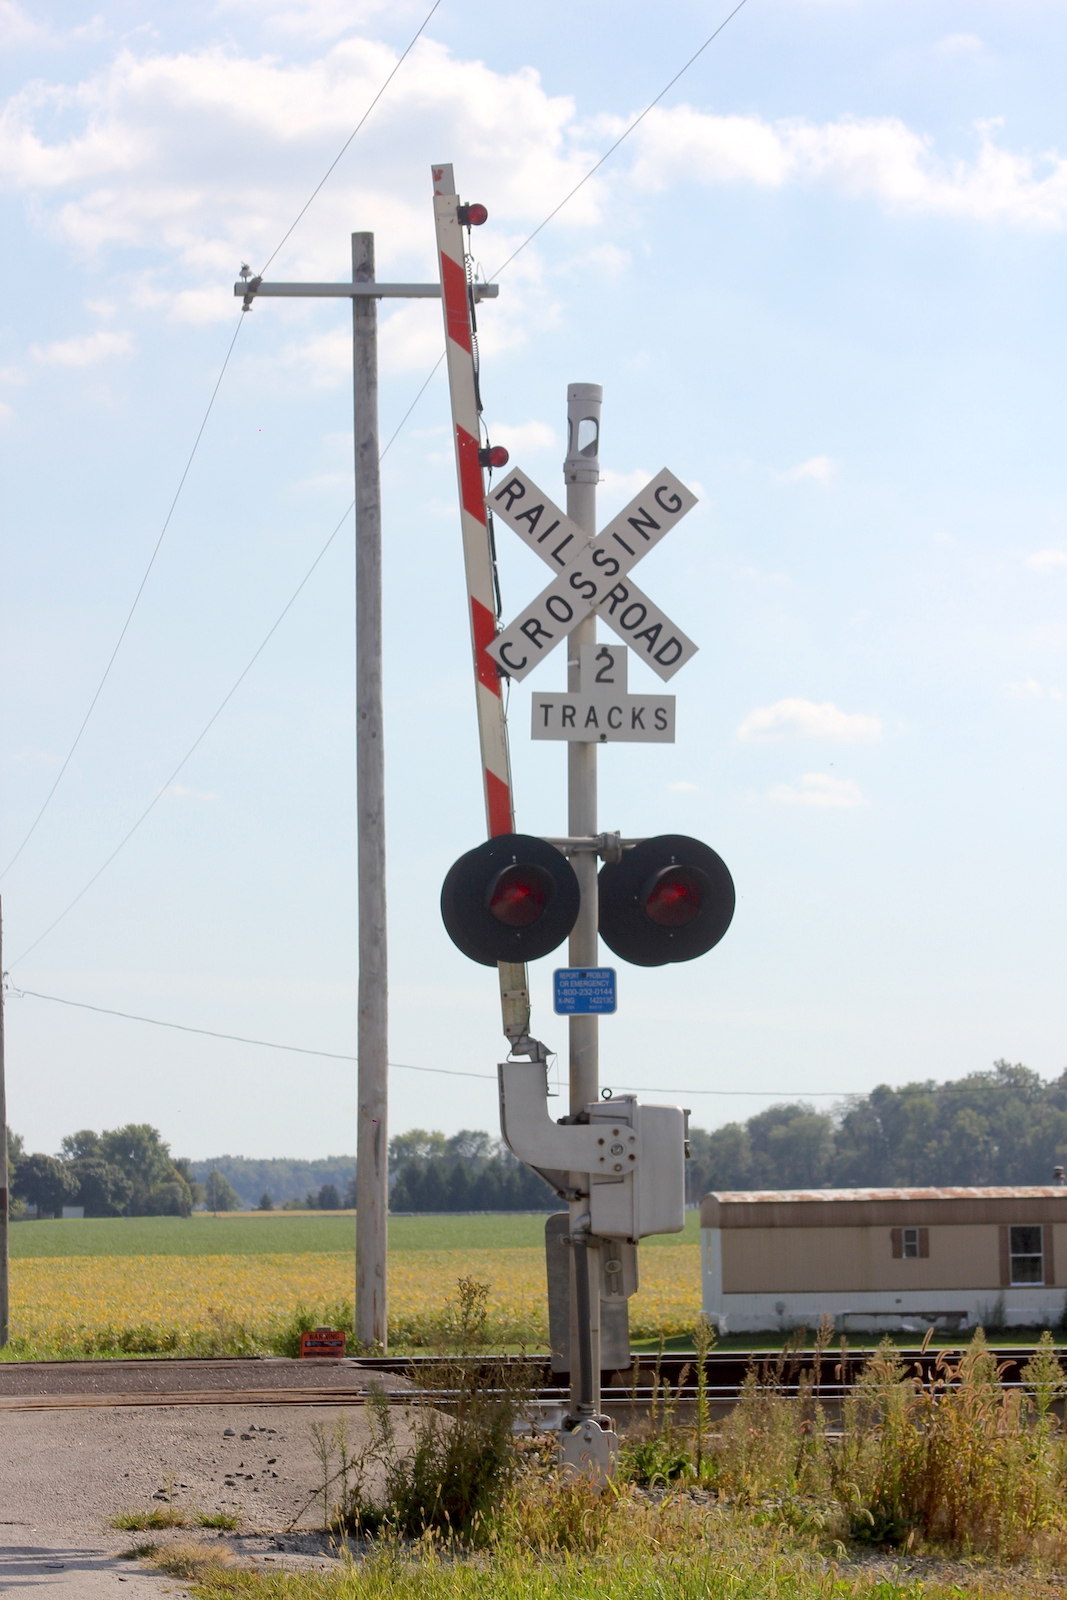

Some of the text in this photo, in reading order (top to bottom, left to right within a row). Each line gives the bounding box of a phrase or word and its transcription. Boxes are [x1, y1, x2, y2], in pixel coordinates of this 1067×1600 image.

[499, 485, 683, 670] CROSSING
[595, 653, 615, 683] 2
[540, 703, 668, 730] TRACKS
